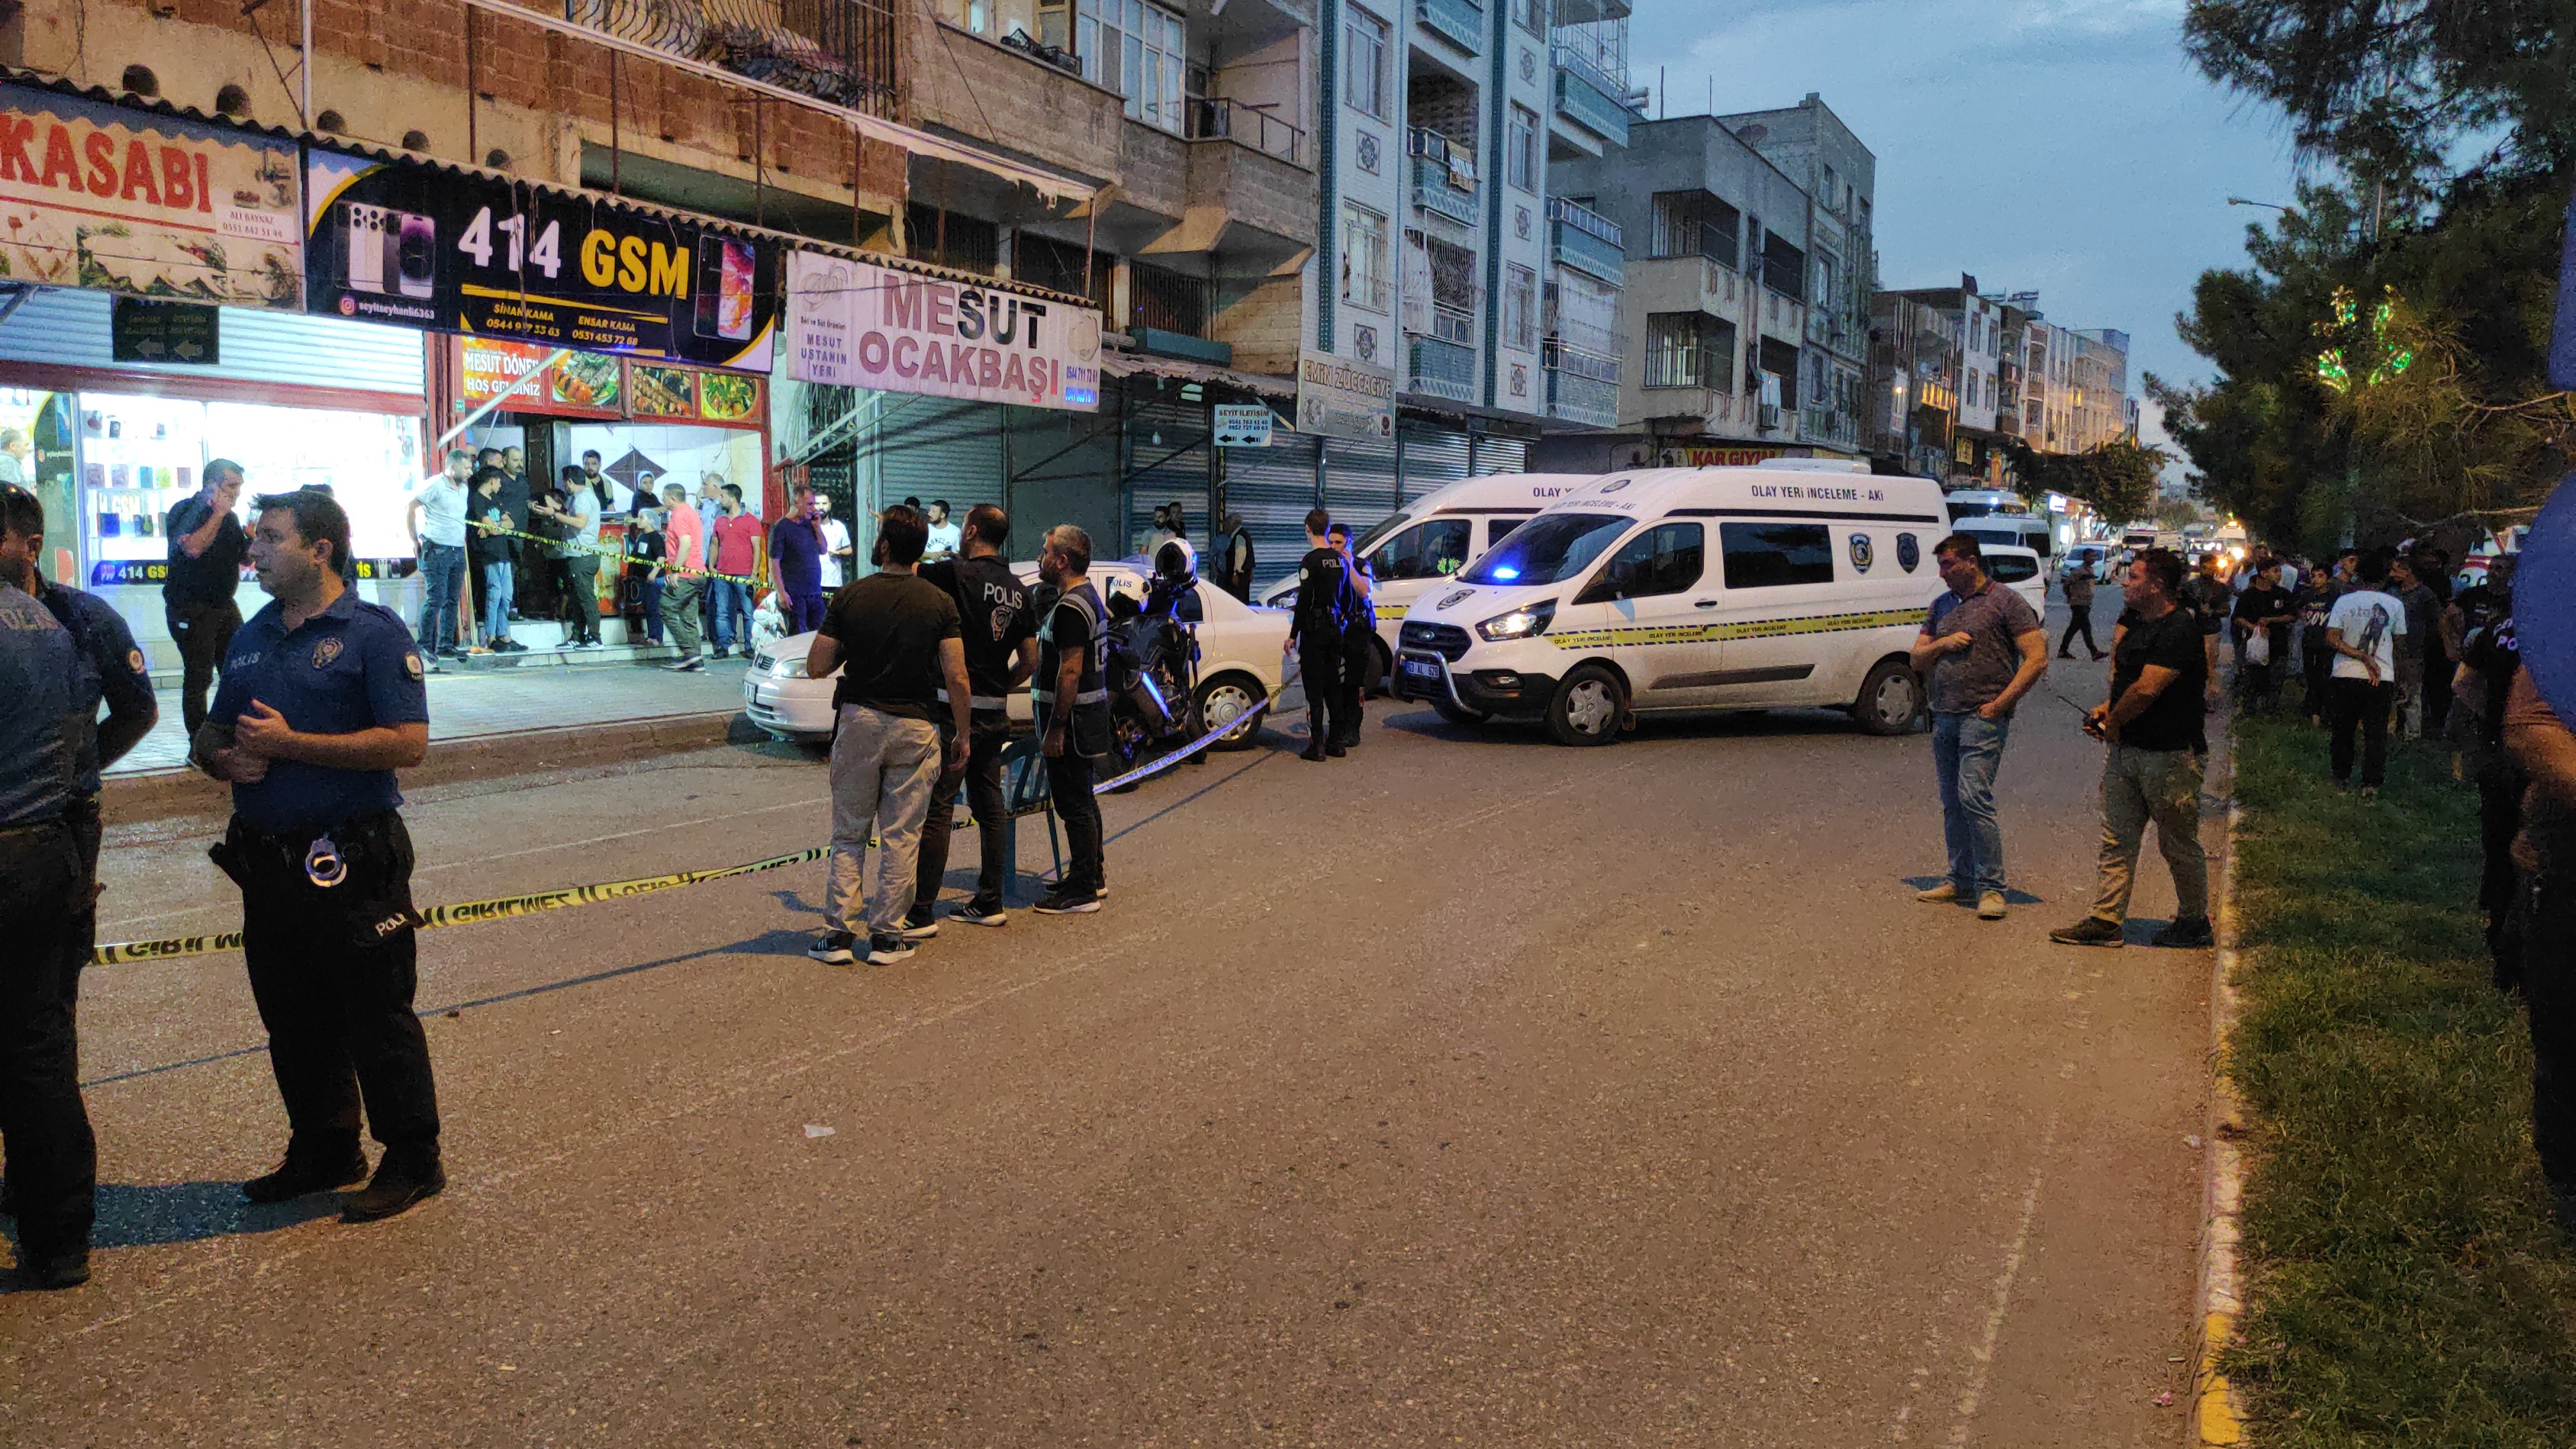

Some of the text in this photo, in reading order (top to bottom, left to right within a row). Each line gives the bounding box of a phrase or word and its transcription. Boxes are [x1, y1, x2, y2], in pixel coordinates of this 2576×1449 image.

[0, 113, 212, 213] KASABI
[458, 207, 689, 299] 414 GSM
[527, 309, 554, 322] KAMA
[883, 274, 1046, 349] MESUT
[578, 316, 636, 333] ENSAR KAMA
[807, 333, 842, 348] MESUT
[465, 352, 501, 373] MESUT
[801, 347, 847, 364] USTANIN
[859, 331, 1059, 402] OCAKBAŞI
[466, 378, 489, 394] HOŞ
[1692, 450, 1726, 466] KAR
[1534, 487, 1561, 497] OLAY
[1752, 485, 1777, 497] OLAY
[118, 565, 168, 579] 414 GS
